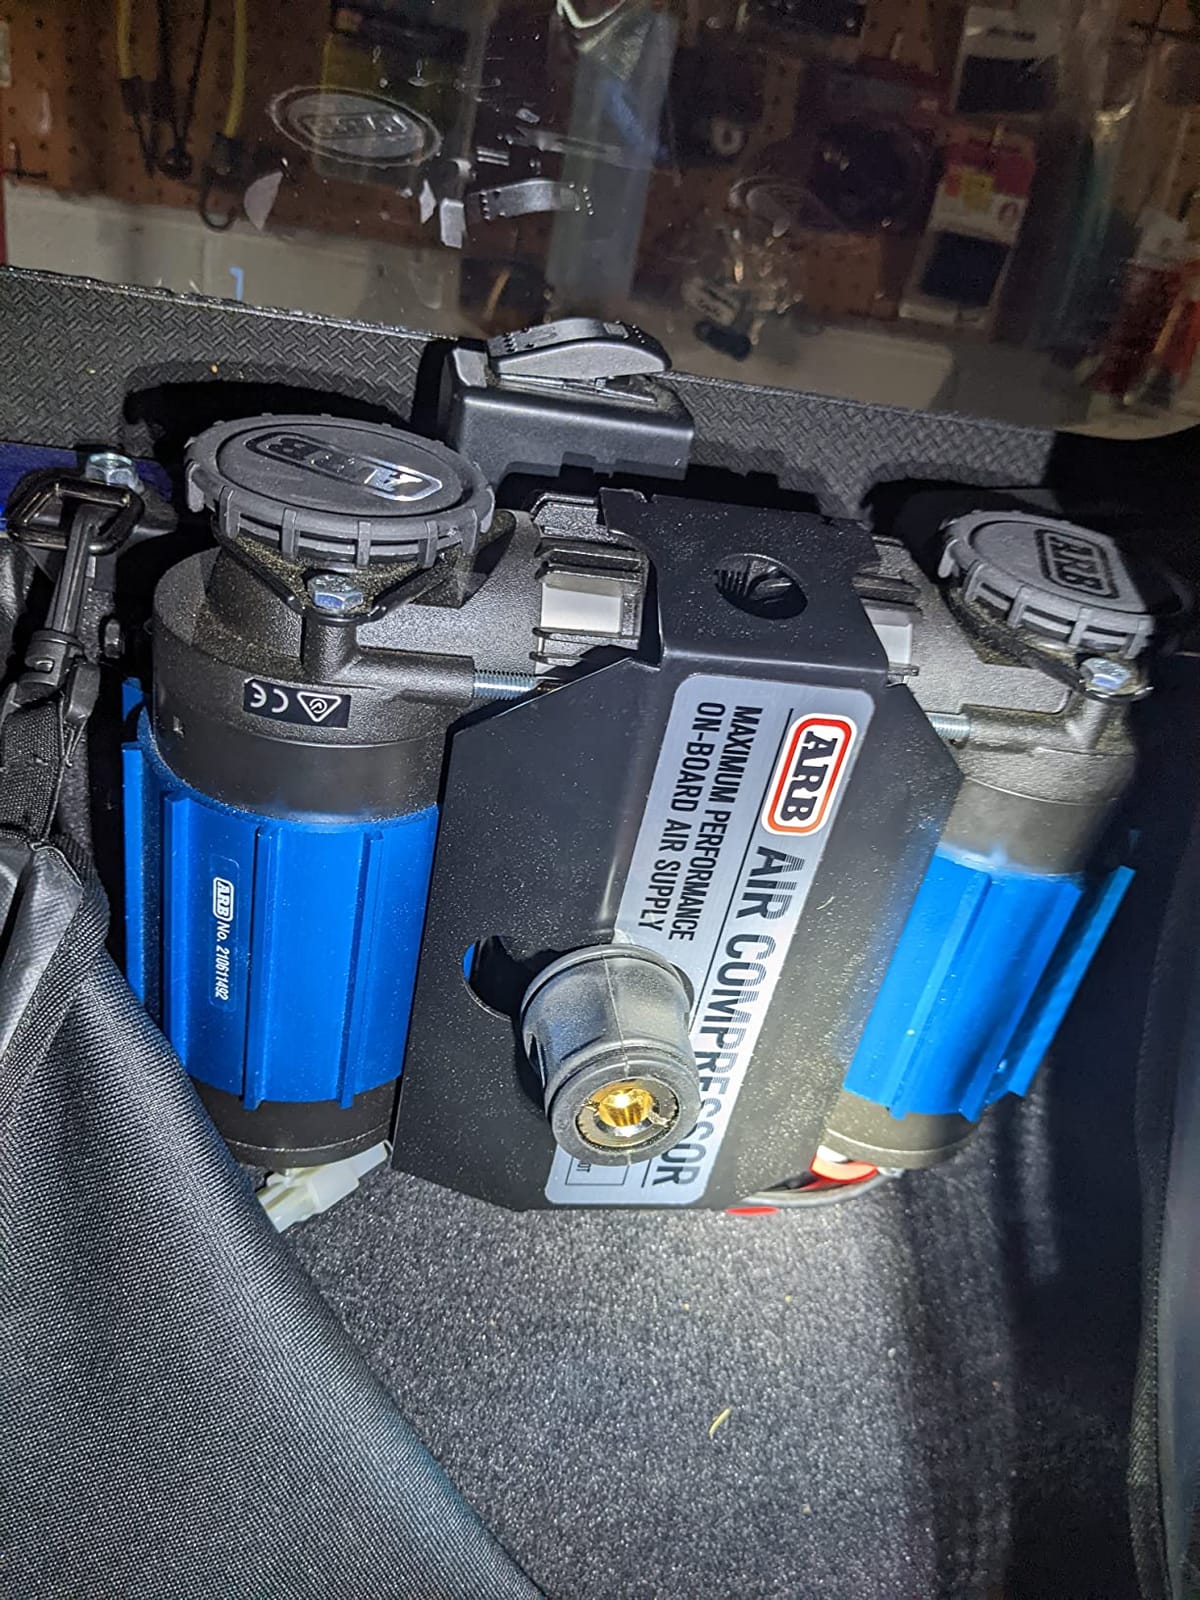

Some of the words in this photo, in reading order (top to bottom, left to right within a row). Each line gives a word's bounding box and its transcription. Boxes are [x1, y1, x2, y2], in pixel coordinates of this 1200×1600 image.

[1050, 534, 1105, 591] ARB
[670, 701, 726, 813] ON-BOARD
[707, 705, 763, 804] MAXIMUM
[780, 730, 838, 822] ARB
[658, 818, 692, 852] AIR
[216, 880, 232, 918] ARB
[638, 858, 681, 932] SUPPLY
[668, 808, 731, 942] PERFORMANCE
[736, 845, 805, 920] AIR
[216, 920, 231, 942] No.
[214, 945, 230, 1001] 210611492
